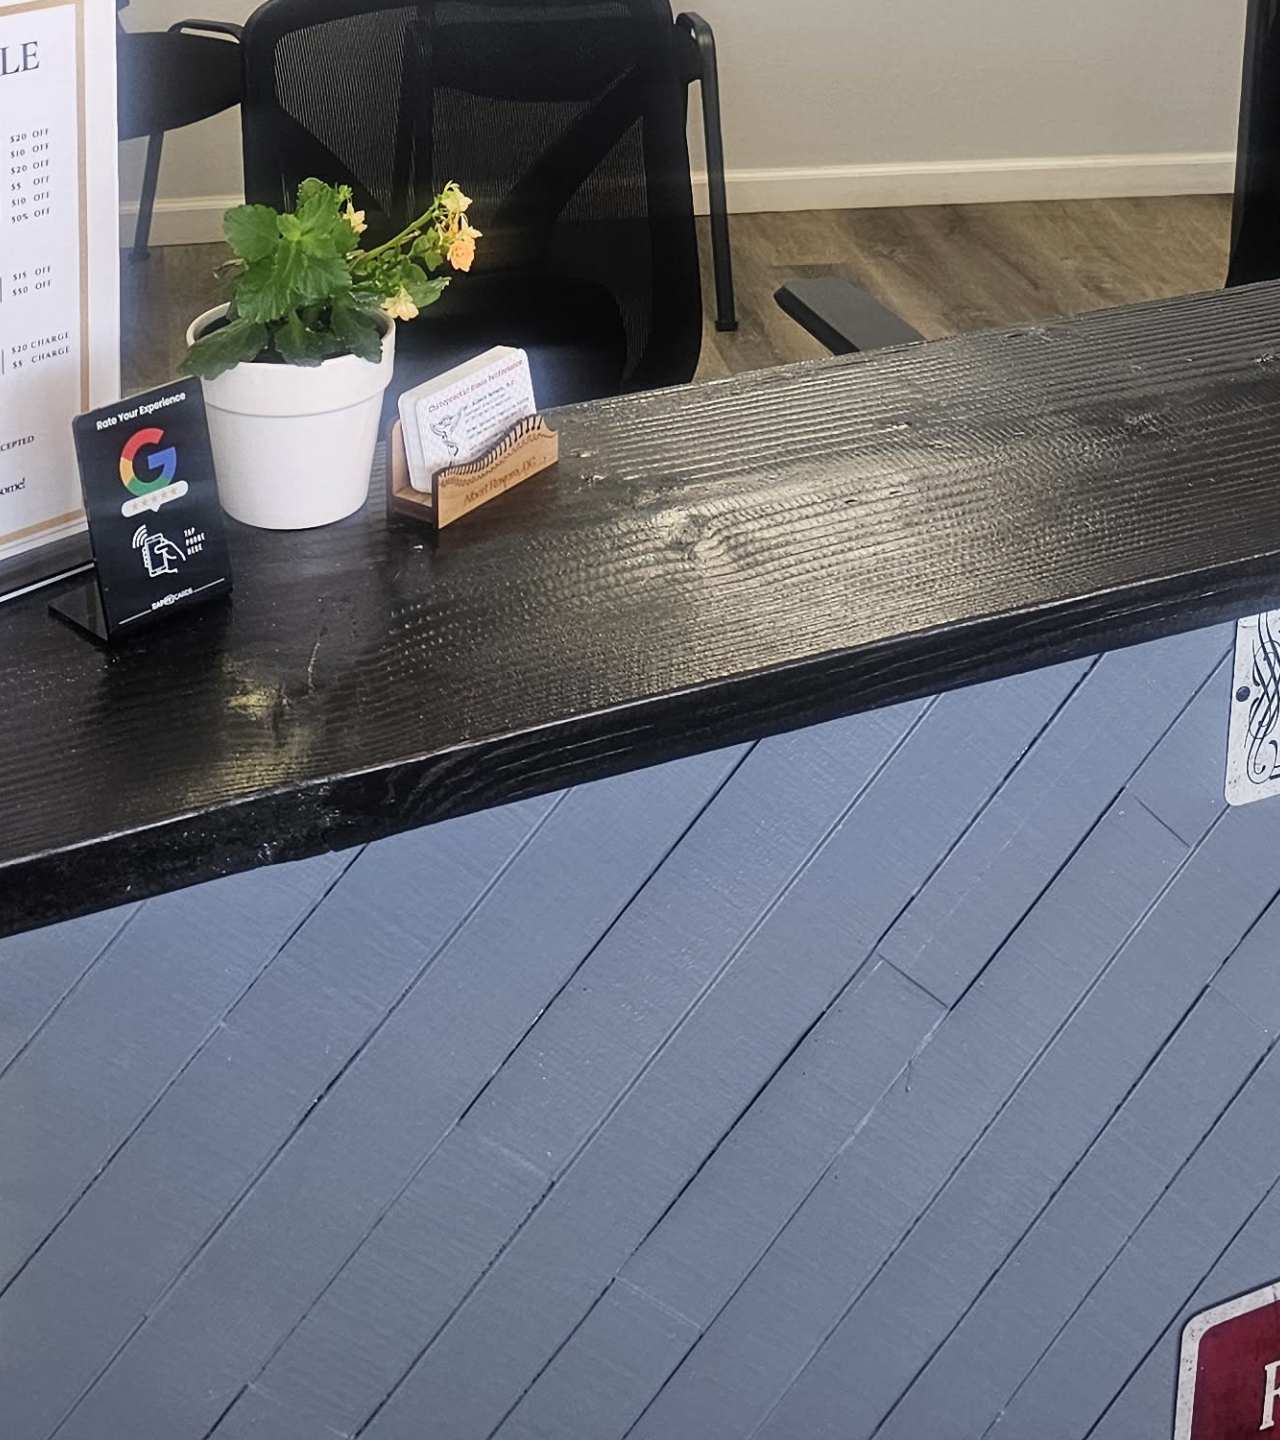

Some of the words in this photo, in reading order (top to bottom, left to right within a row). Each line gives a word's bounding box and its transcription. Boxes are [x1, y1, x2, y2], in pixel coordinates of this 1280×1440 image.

[96, 417, 117, 431] Rate
[117, 409, 139, 424] Your
[139, 392, 186, 416] Experience
